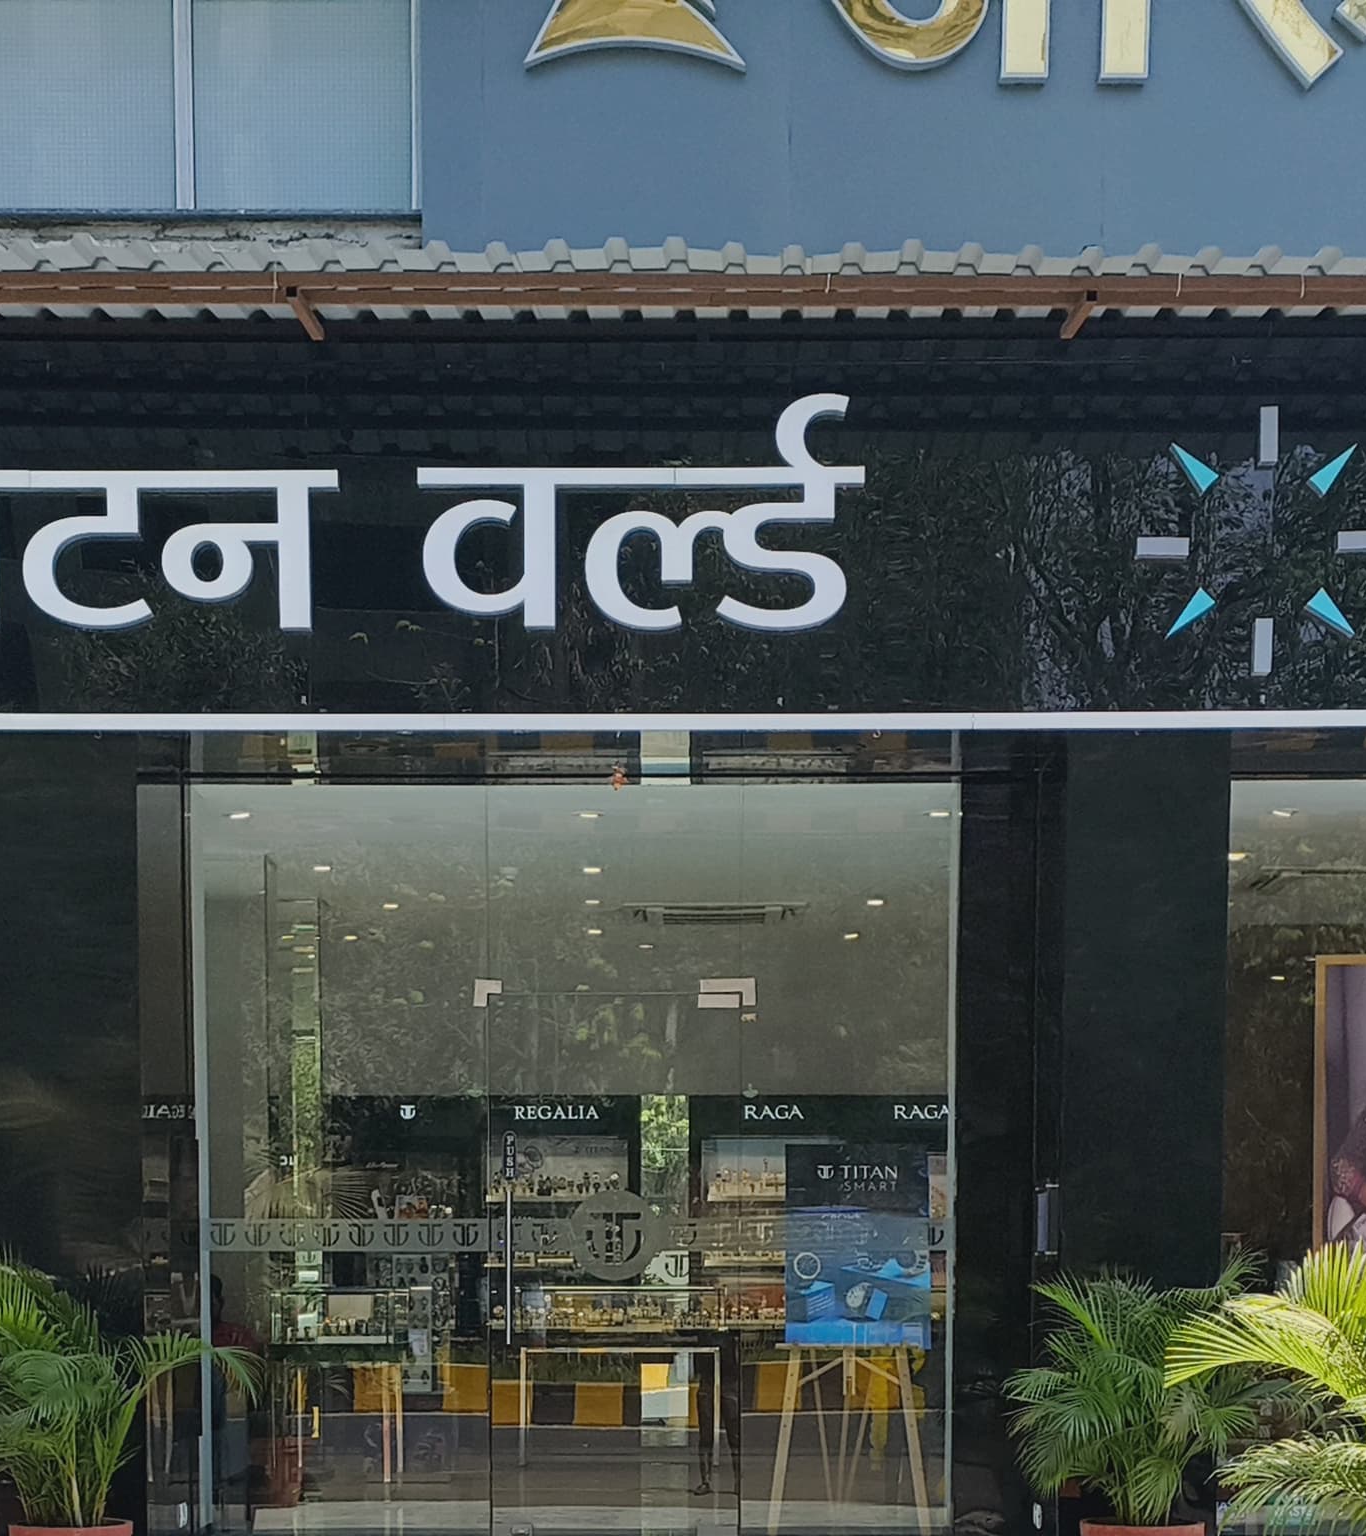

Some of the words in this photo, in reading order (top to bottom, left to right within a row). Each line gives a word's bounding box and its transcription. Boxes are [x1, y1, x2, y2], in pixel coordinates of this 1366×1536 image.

[416, 393, 866, 634] वर्ल्ड
[514, 1105, 600, 1120] REGALIA
[743, 1104, 805, 1120] RAGA
[893, 1104, 950, 1120] RAGA
[506, 1135, 515, 1178] PUSH
[839, 1165, 898, 1179] TITAN
[843, 1181, 897, 1192] SMART
